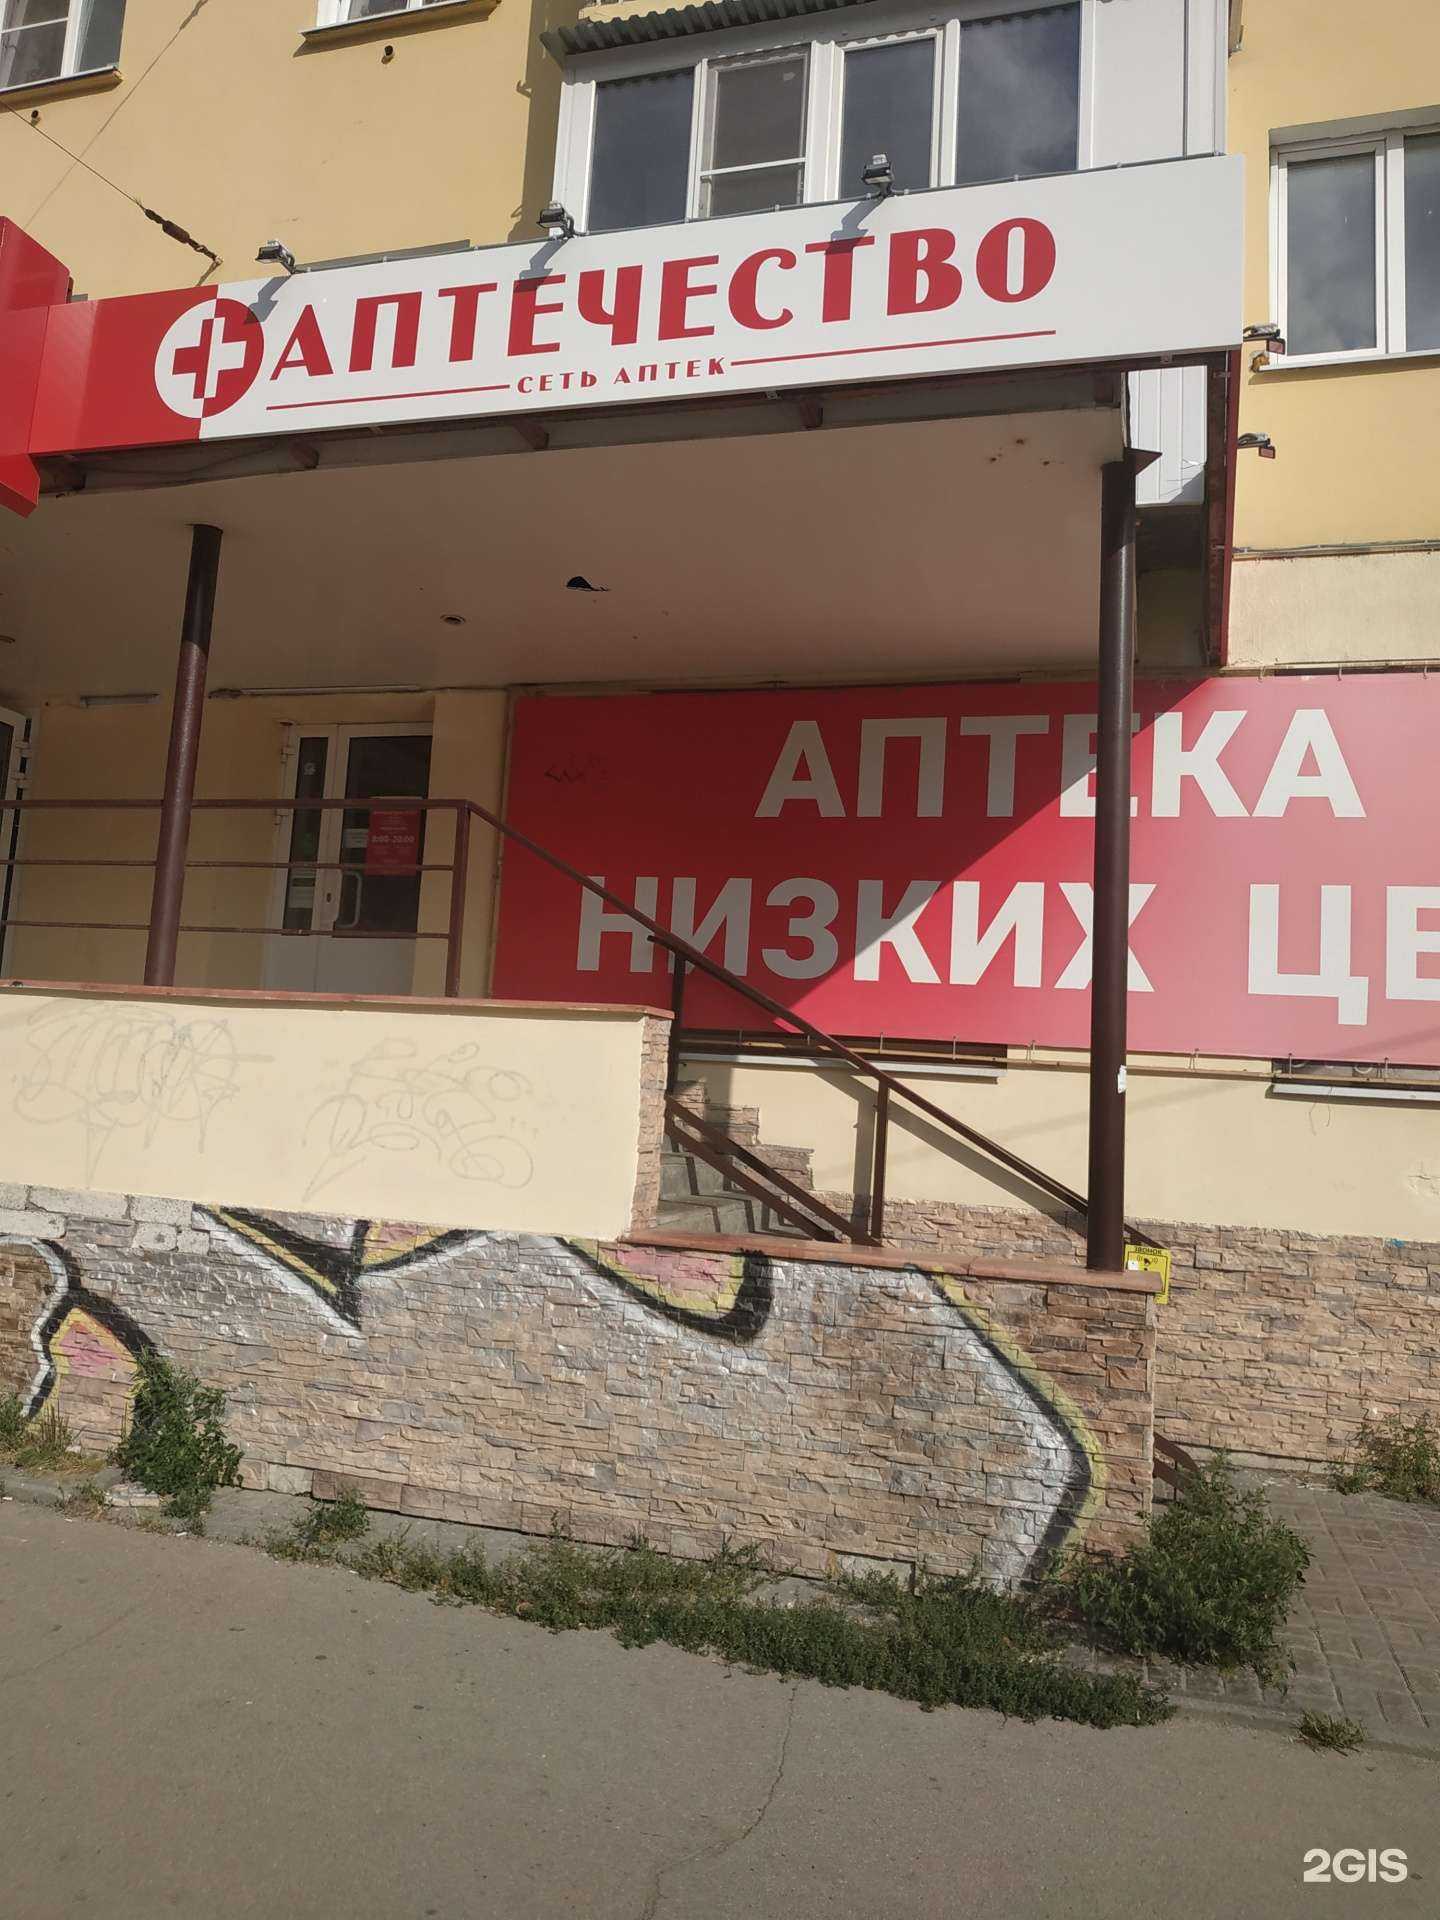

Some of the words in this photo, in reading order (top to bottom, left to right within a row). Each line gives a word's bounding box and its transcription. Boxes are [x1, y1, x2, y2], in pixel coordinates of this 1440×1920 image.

[269, 217, 1056, 380] АПТЕЧЕСТВО
[517, 370, 597, 394] СЕТЬ
[618, 357, 725, 385] АПТЕК
[754, 708, 1366, 818] АПТЕКА
[576, 875, 1157, 993] НИЗКИХ
[1248, 884, 1440, 1025] ЦЕ
